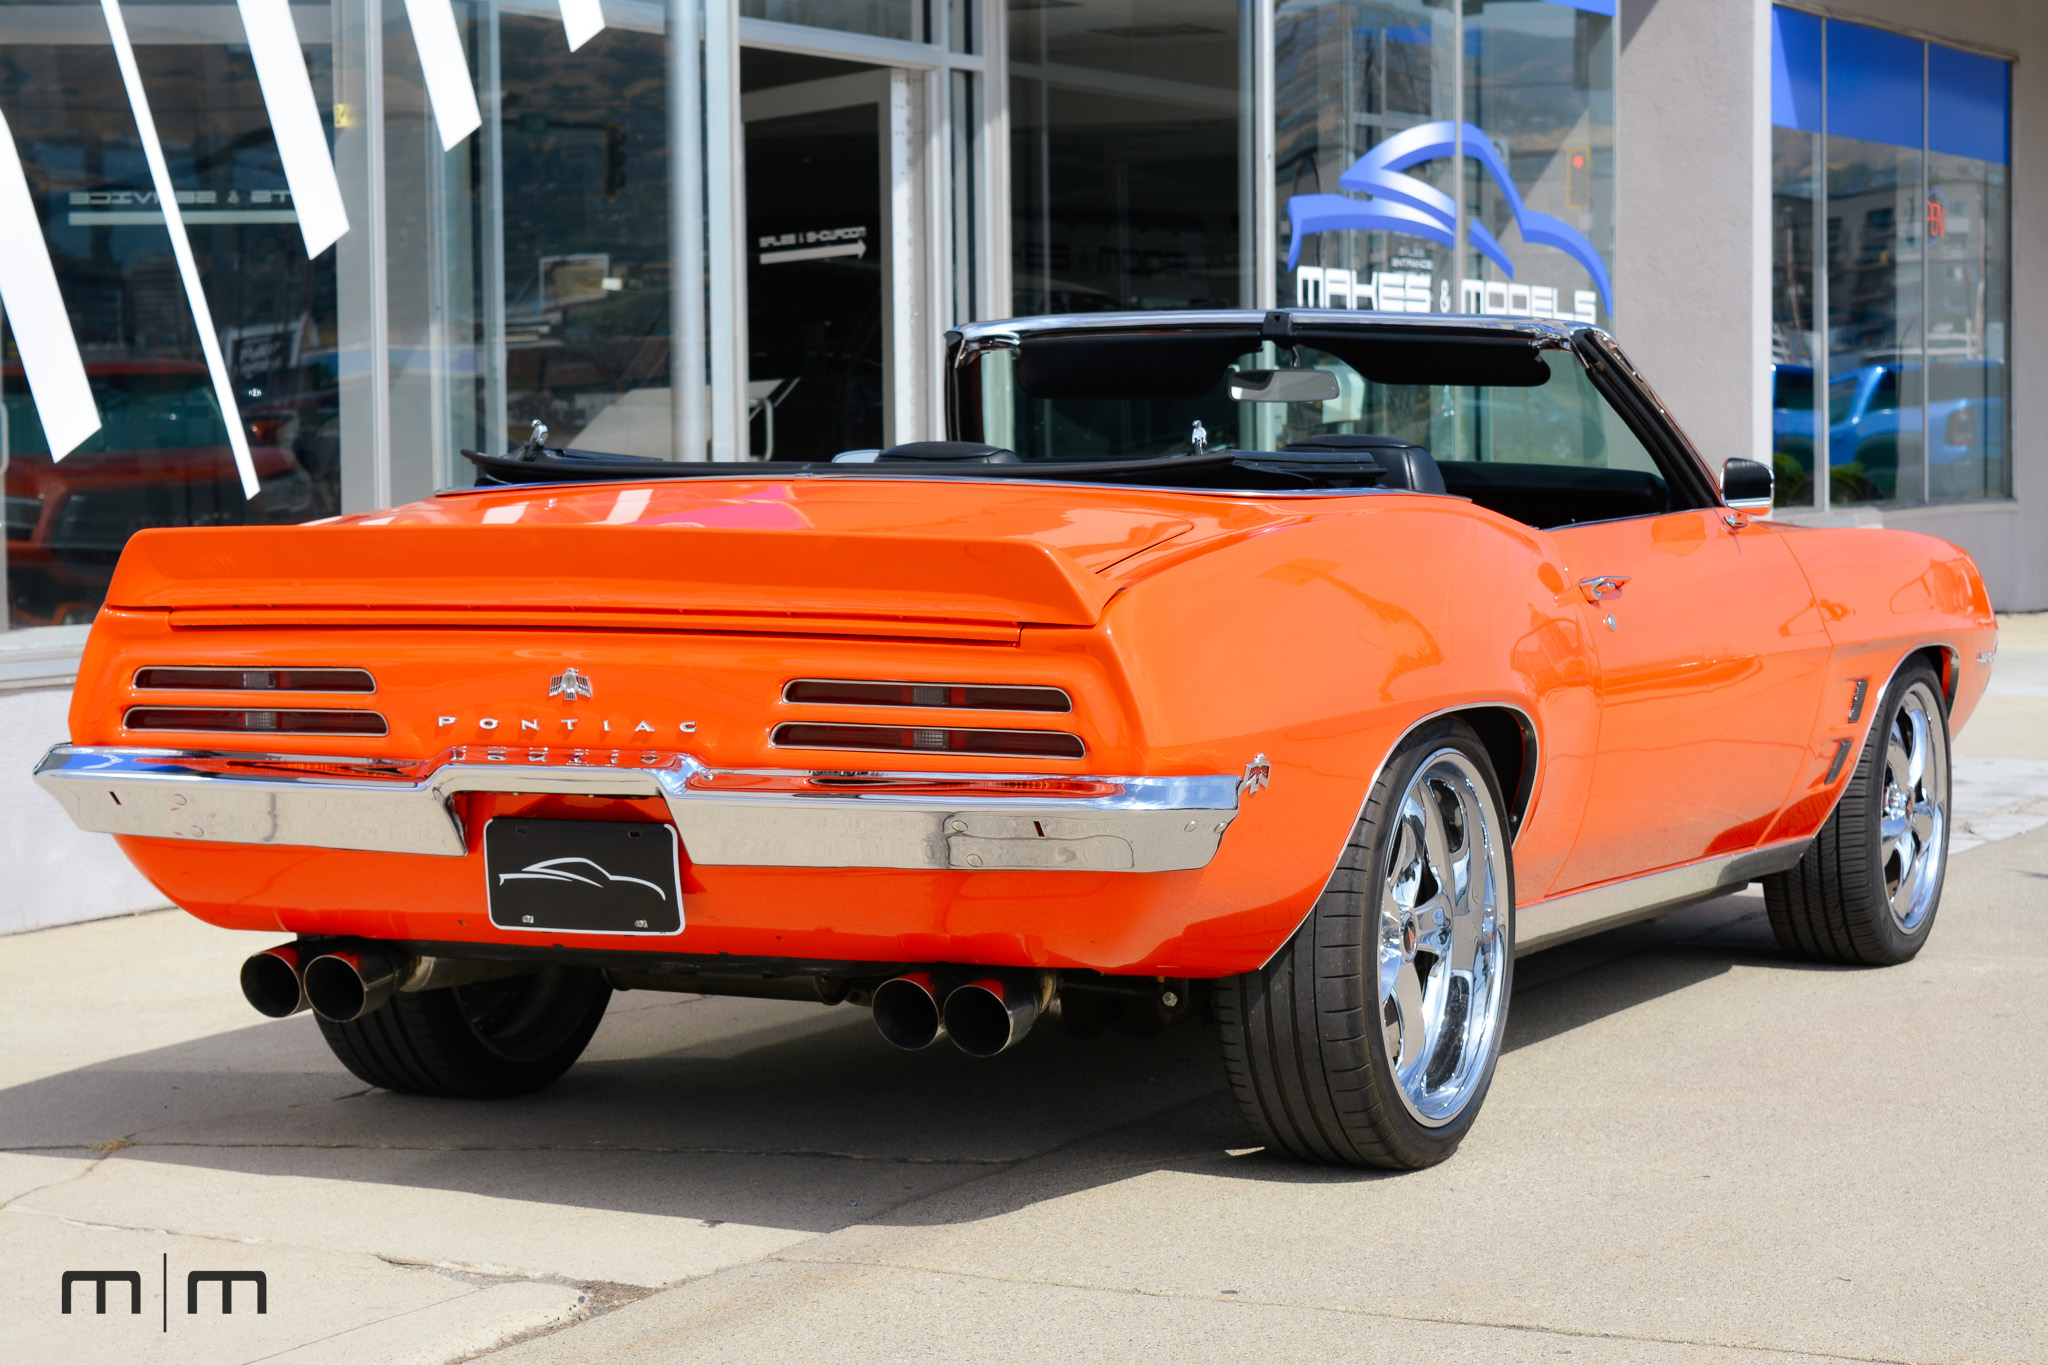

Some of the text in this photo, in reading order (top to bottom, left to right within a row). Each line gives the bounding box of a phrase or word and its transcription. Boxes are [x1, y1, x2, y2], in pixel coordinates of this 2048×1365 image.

[1391, 257, 1433, 270] ENTRANCE
[1297, 265, 1597, 325] MAKES & MODELS
[438, 716, 697, 733] PONTIAC
